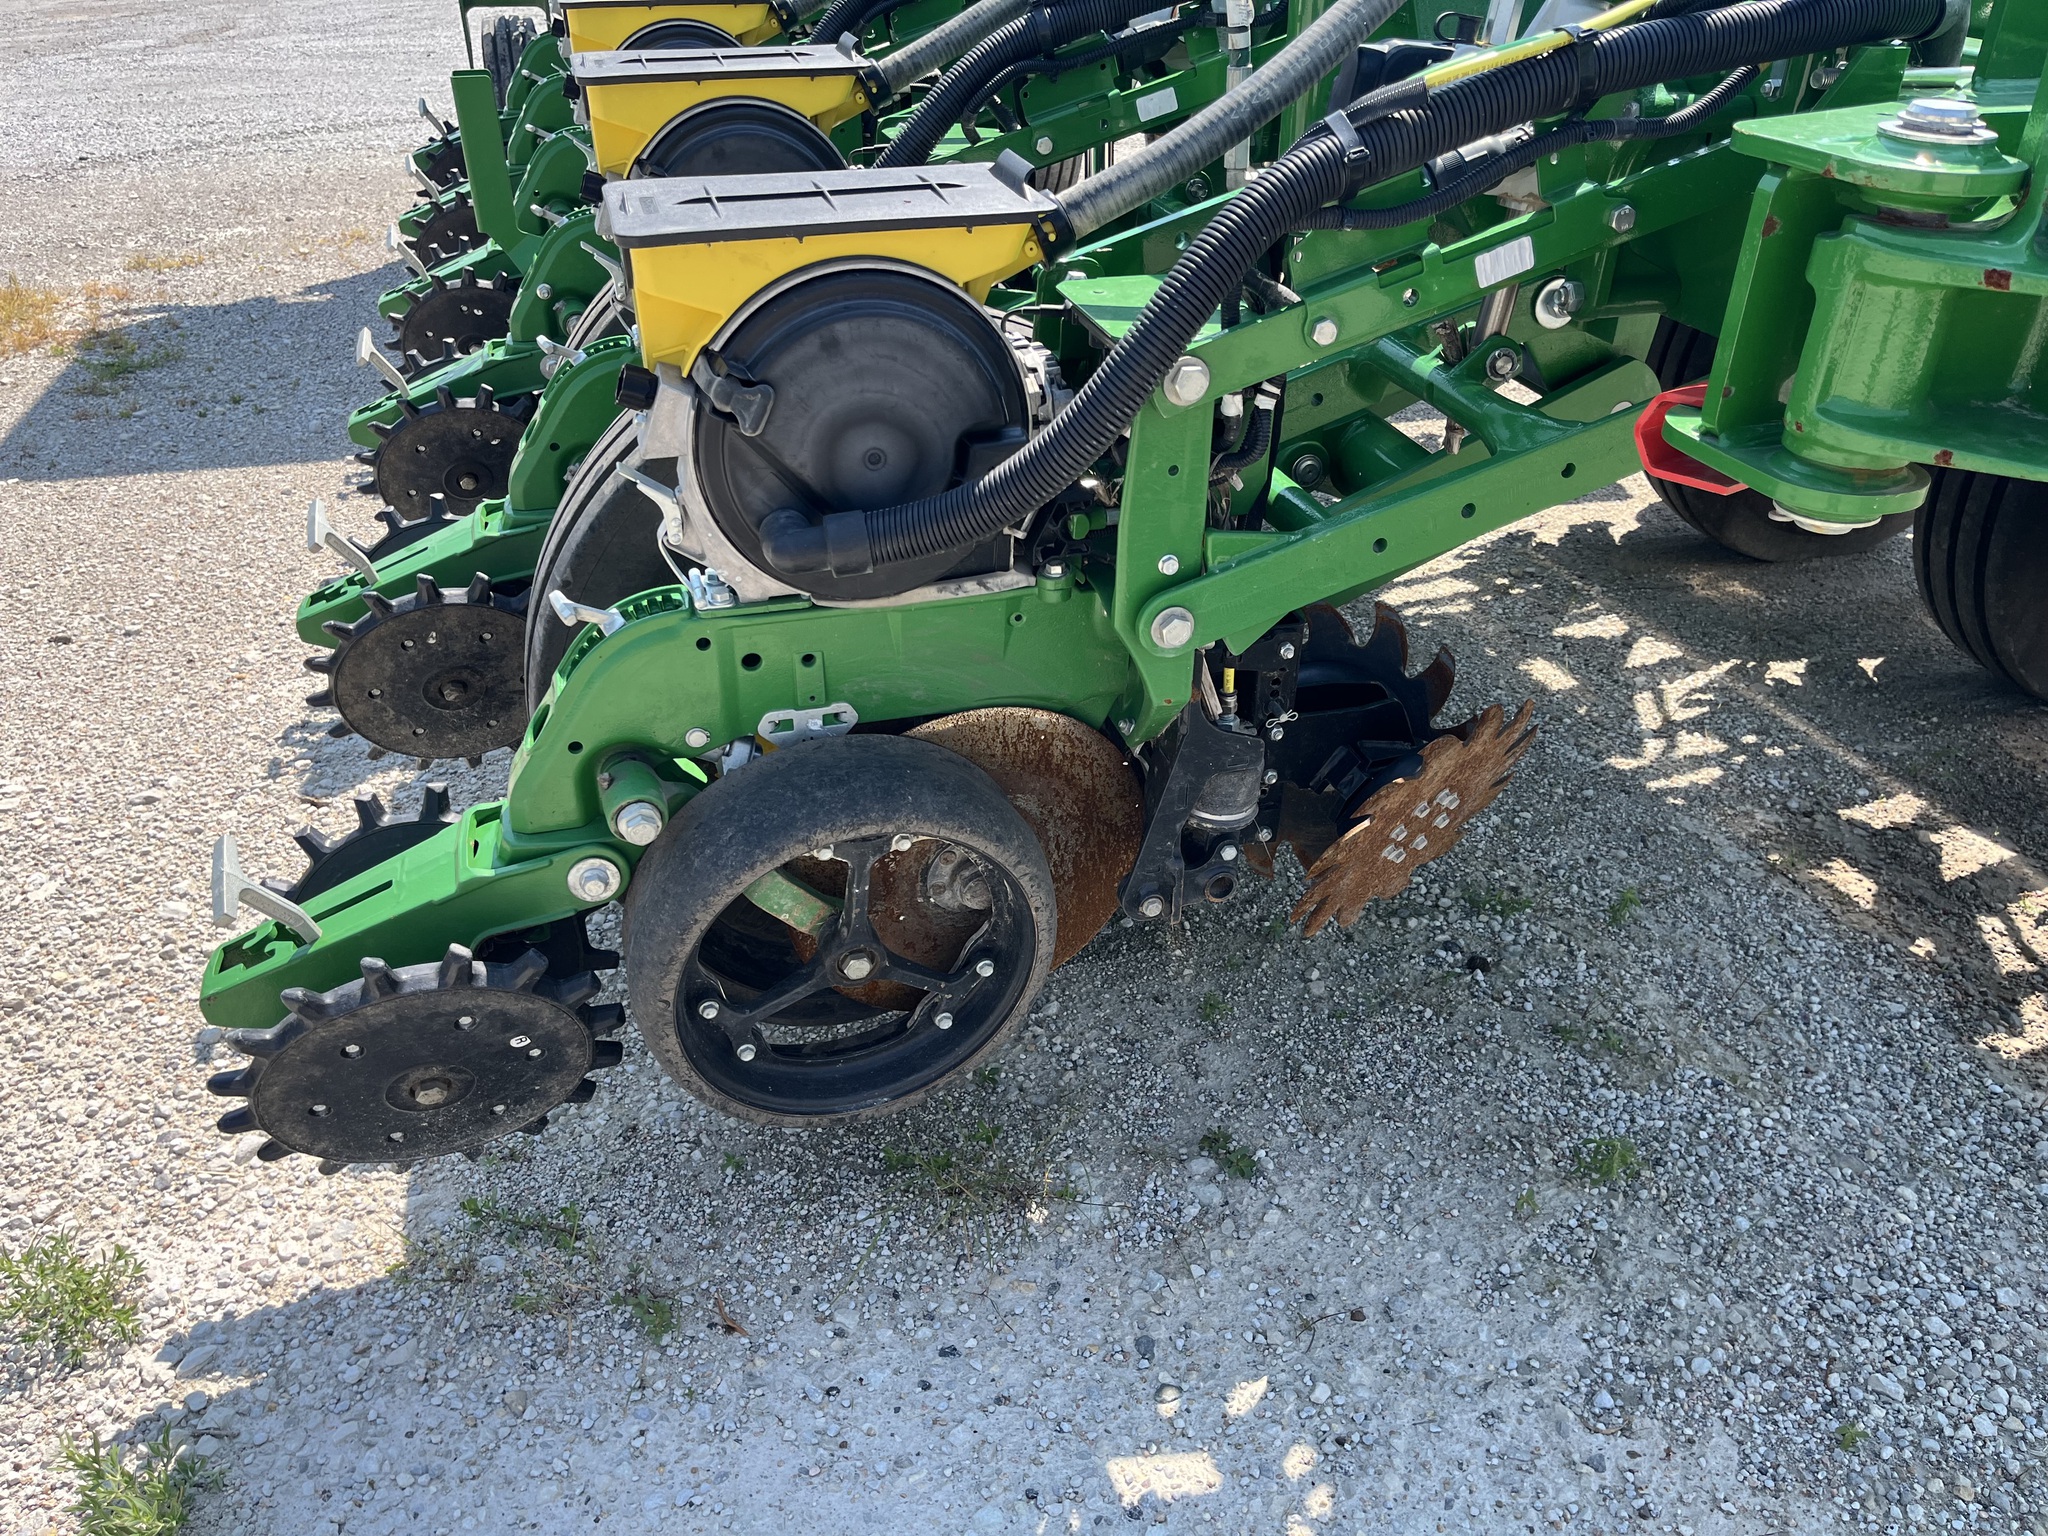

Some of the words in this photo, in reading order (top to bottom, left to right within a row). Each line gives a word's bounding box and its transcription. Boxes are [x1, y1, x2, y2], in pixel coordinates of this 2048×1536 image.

[1346, 4, 1367, 23] 16
[1317, 29, 1340, 50] TO
[1288, 53, 1311, 75] RU
